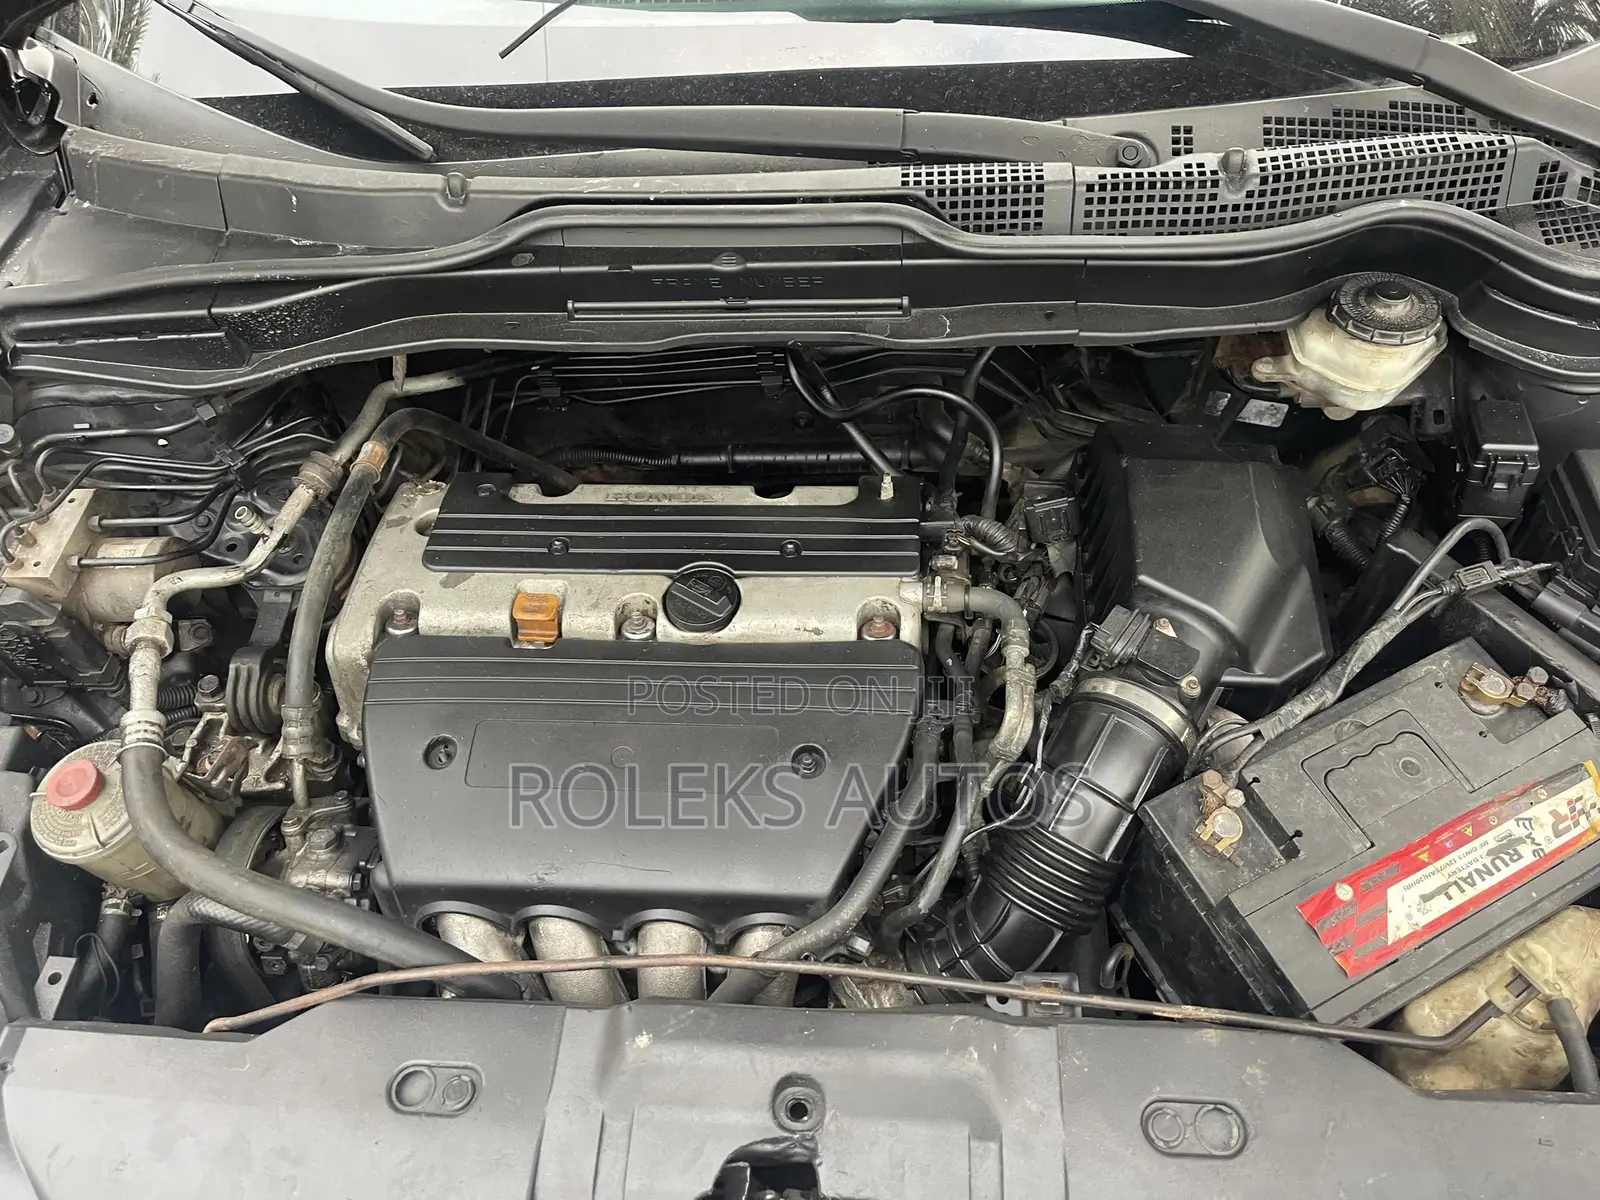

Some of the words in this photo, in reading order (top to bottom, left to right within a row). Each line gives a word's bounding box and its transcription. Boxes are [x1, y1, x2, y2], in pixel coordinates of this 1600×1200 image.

[651, 277, 723, 288] FRAME
[739, 276, 824, 288] NUMBER
[1447, 858, 1480, 879] BATTERY
